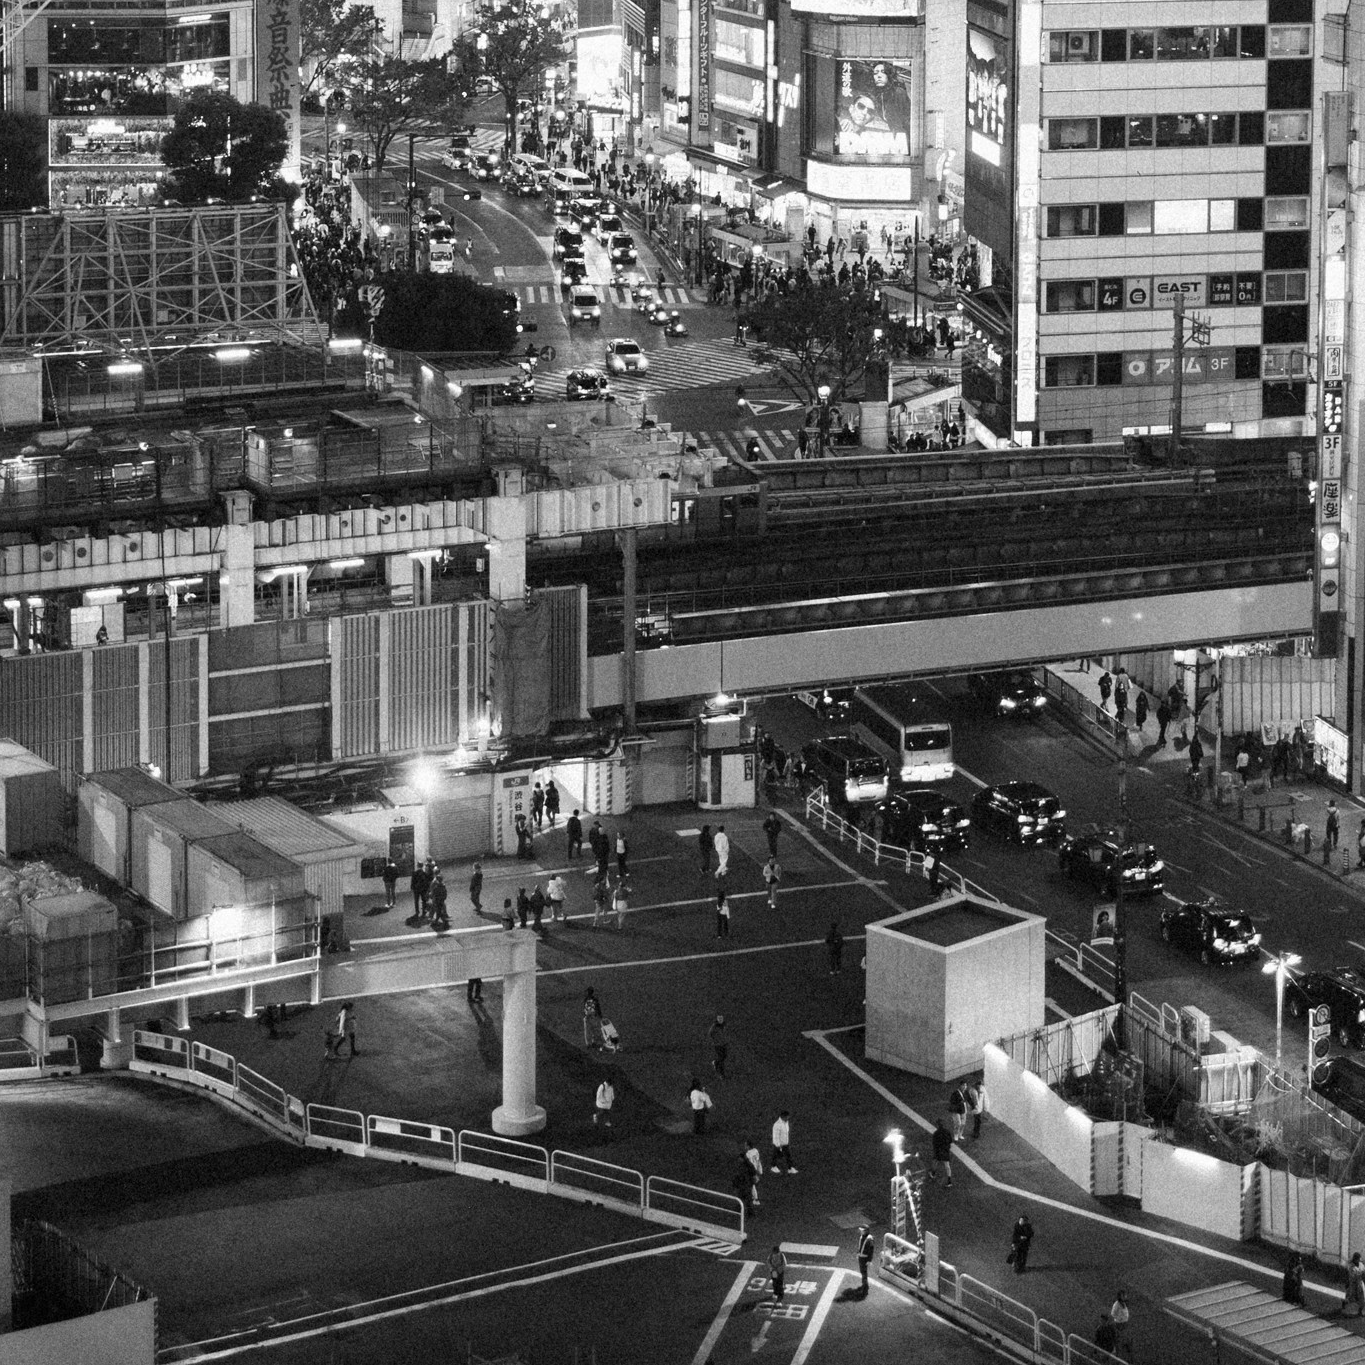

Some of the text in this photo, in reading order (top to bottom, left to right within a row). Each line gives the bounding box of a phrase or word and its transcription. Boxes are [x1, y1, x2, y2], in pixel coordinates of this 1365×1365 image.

[1157, 282, 1202, 294] EAST
[1104, 292, 1118, 305] 4F
[1211, 357, 1229, 371] 3F
[1324, 438, 1340, 449] 3F
